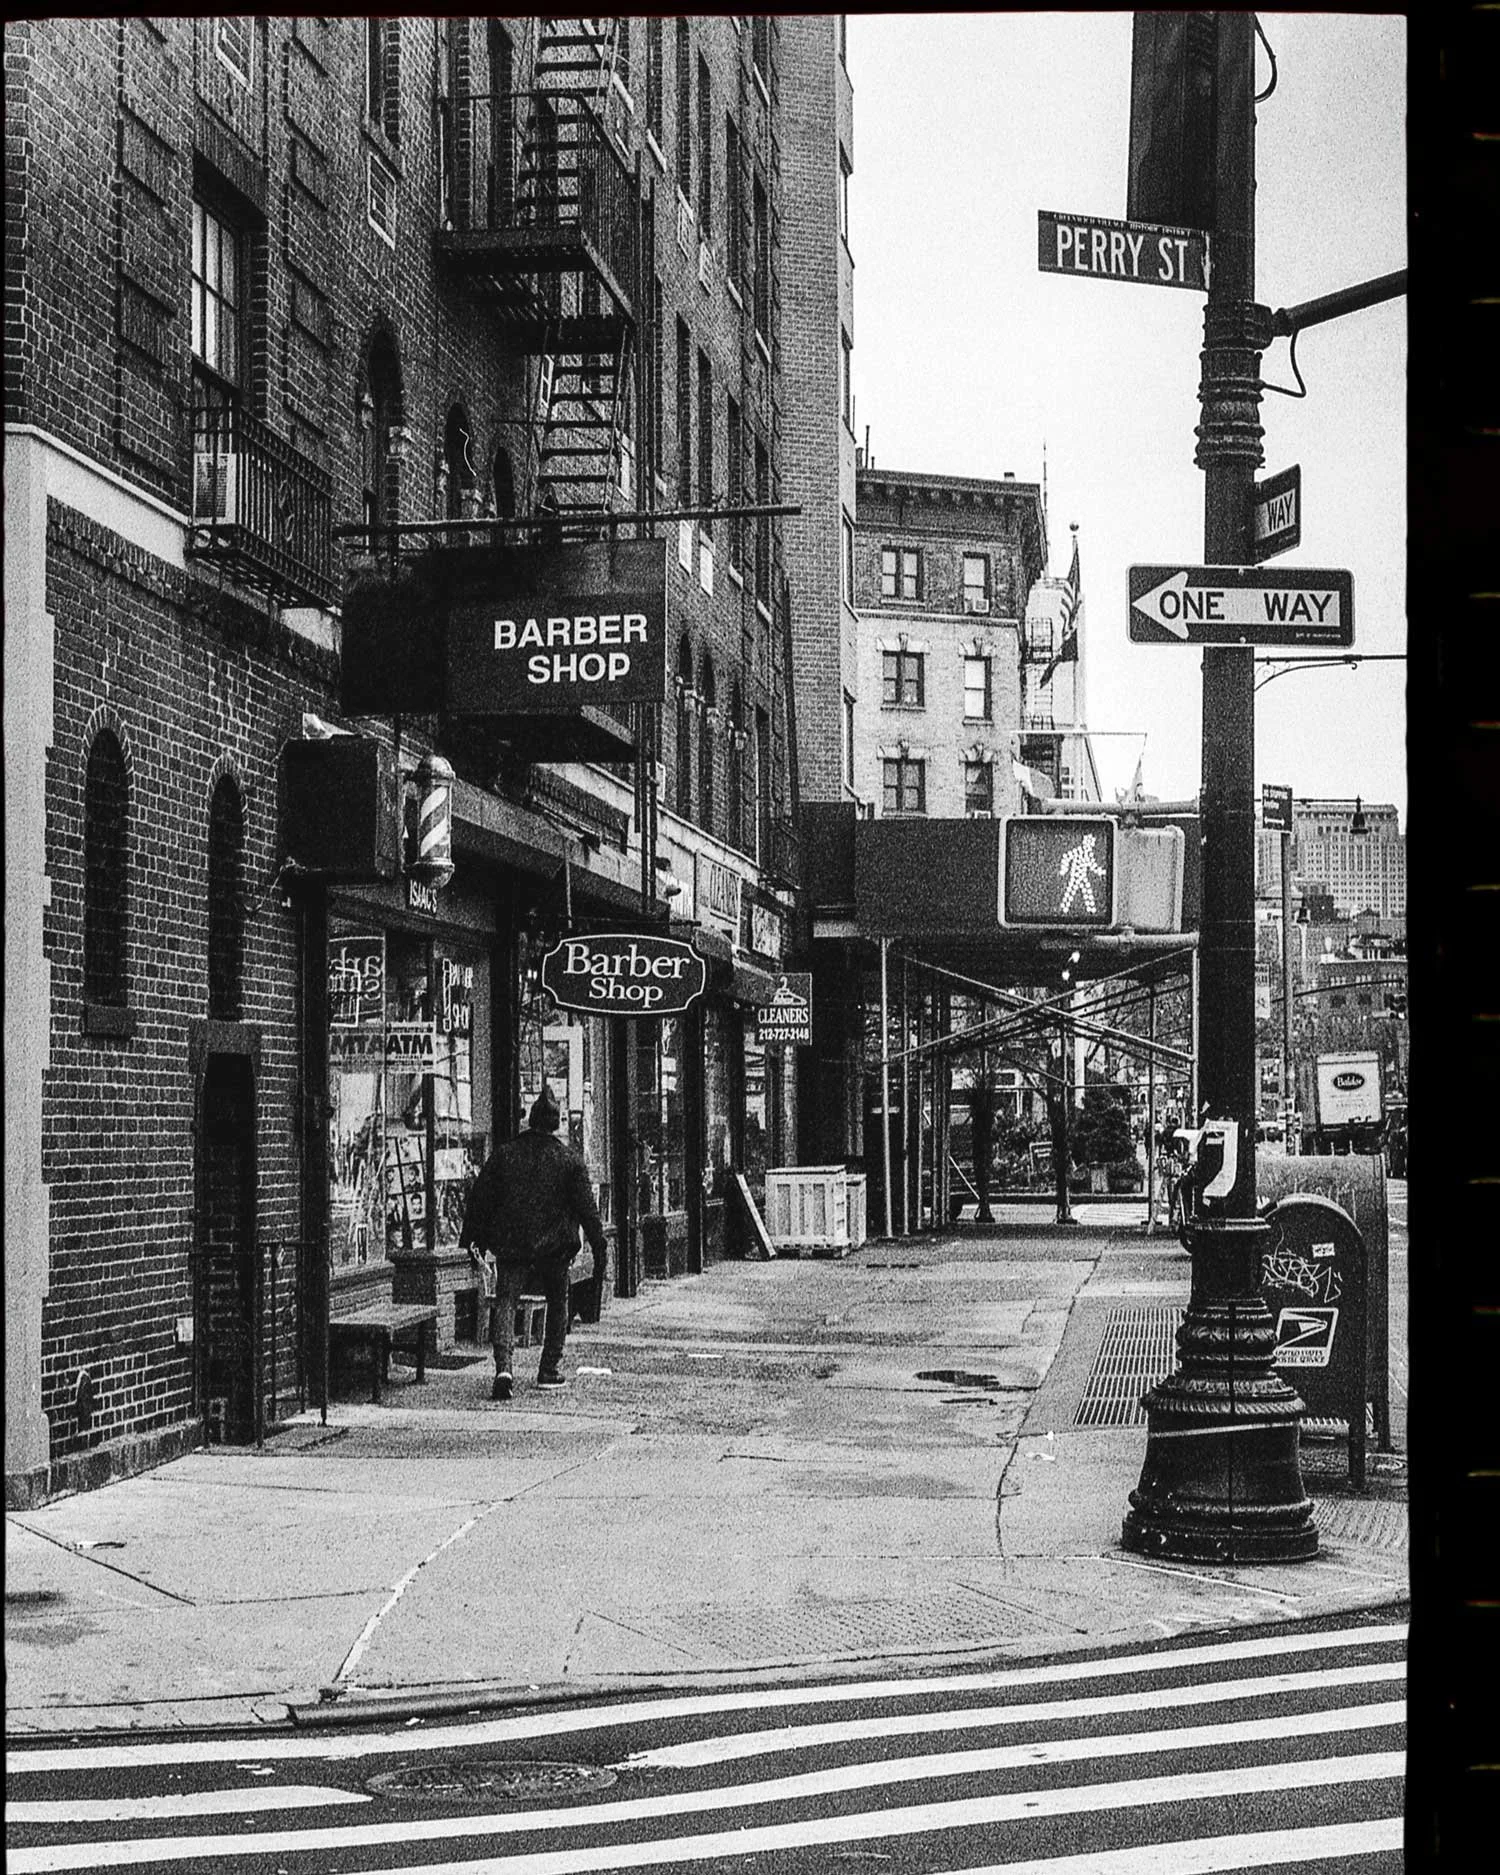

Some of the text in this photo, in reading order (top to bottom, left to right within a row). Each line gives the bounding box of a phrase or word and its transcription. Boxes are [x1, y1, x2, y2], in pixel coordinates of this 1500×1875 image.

[1056, 223, 1188, 282] PERRY ST
[1266, 491, 1293, 532] WAY
[1159, 590, 1333, 622] ONE WAY
[494, 613, 648, 650] BARBER
[527, 652, 631, 684] SHOP
[563, 943, 691, 980] Barber
[589, 977, 664, 1009] Shop
[758, 1007, 809, 1024] CLEANERS
[386, 1034, 434, 1055] ATM
[758, 1027, 810, 1041] 212-727-2148
